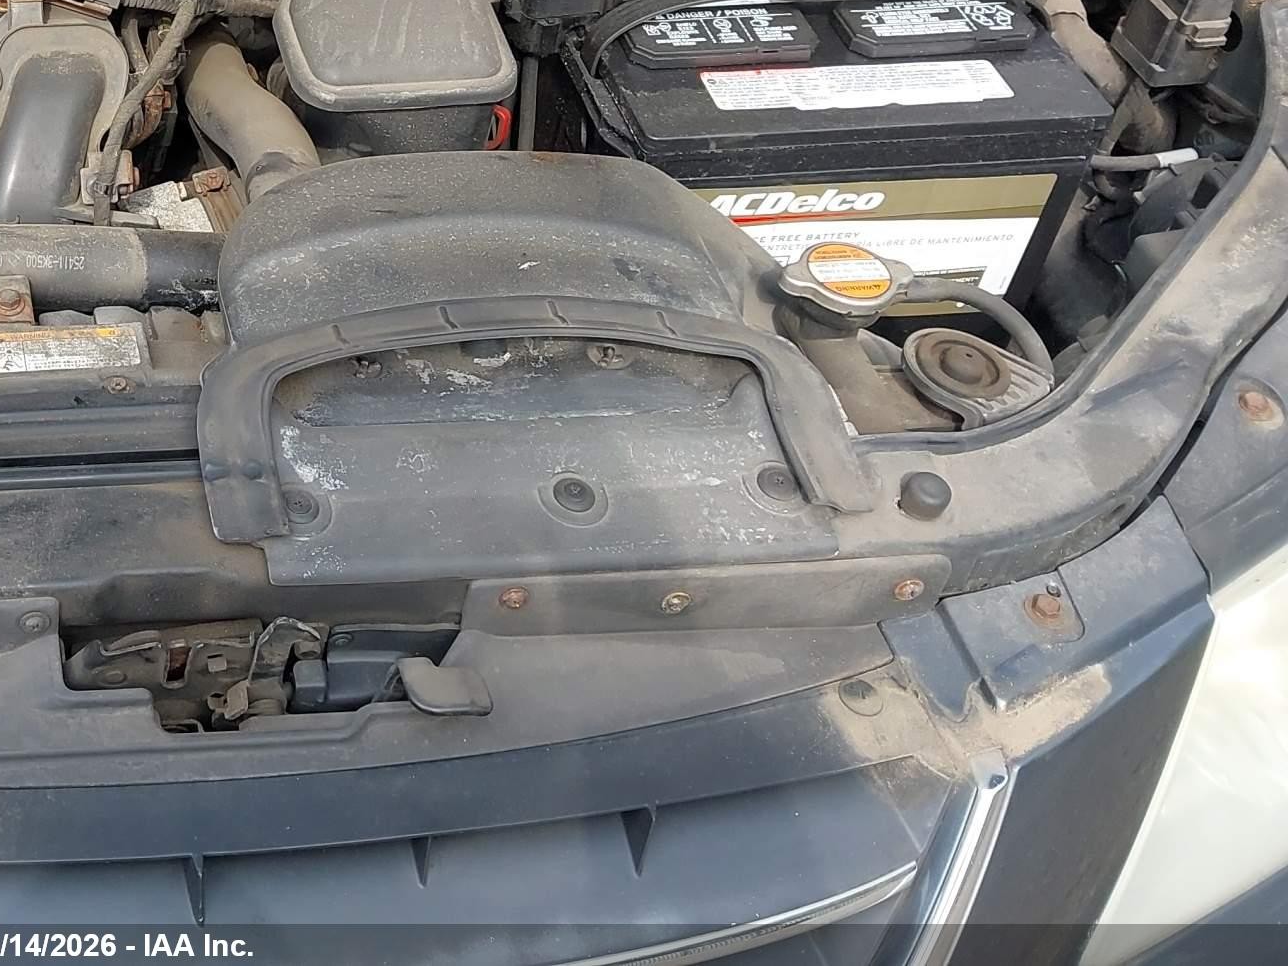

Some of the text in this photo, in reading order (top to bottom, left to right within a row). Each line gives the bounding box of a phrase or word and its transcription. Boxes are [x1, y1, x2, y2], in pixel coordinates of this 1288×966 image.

[666, 10, 714, 19] DANGER
[725, 8, 768, 16] POISON
[710, 189, 885, 216] ACDelco
[771, 234, 802, 242] FREE
[806, 232, 860, 241] BATTERY
[910, 237, 925, 245] DE
[25, 254, 85, 270] 25411-3K500
